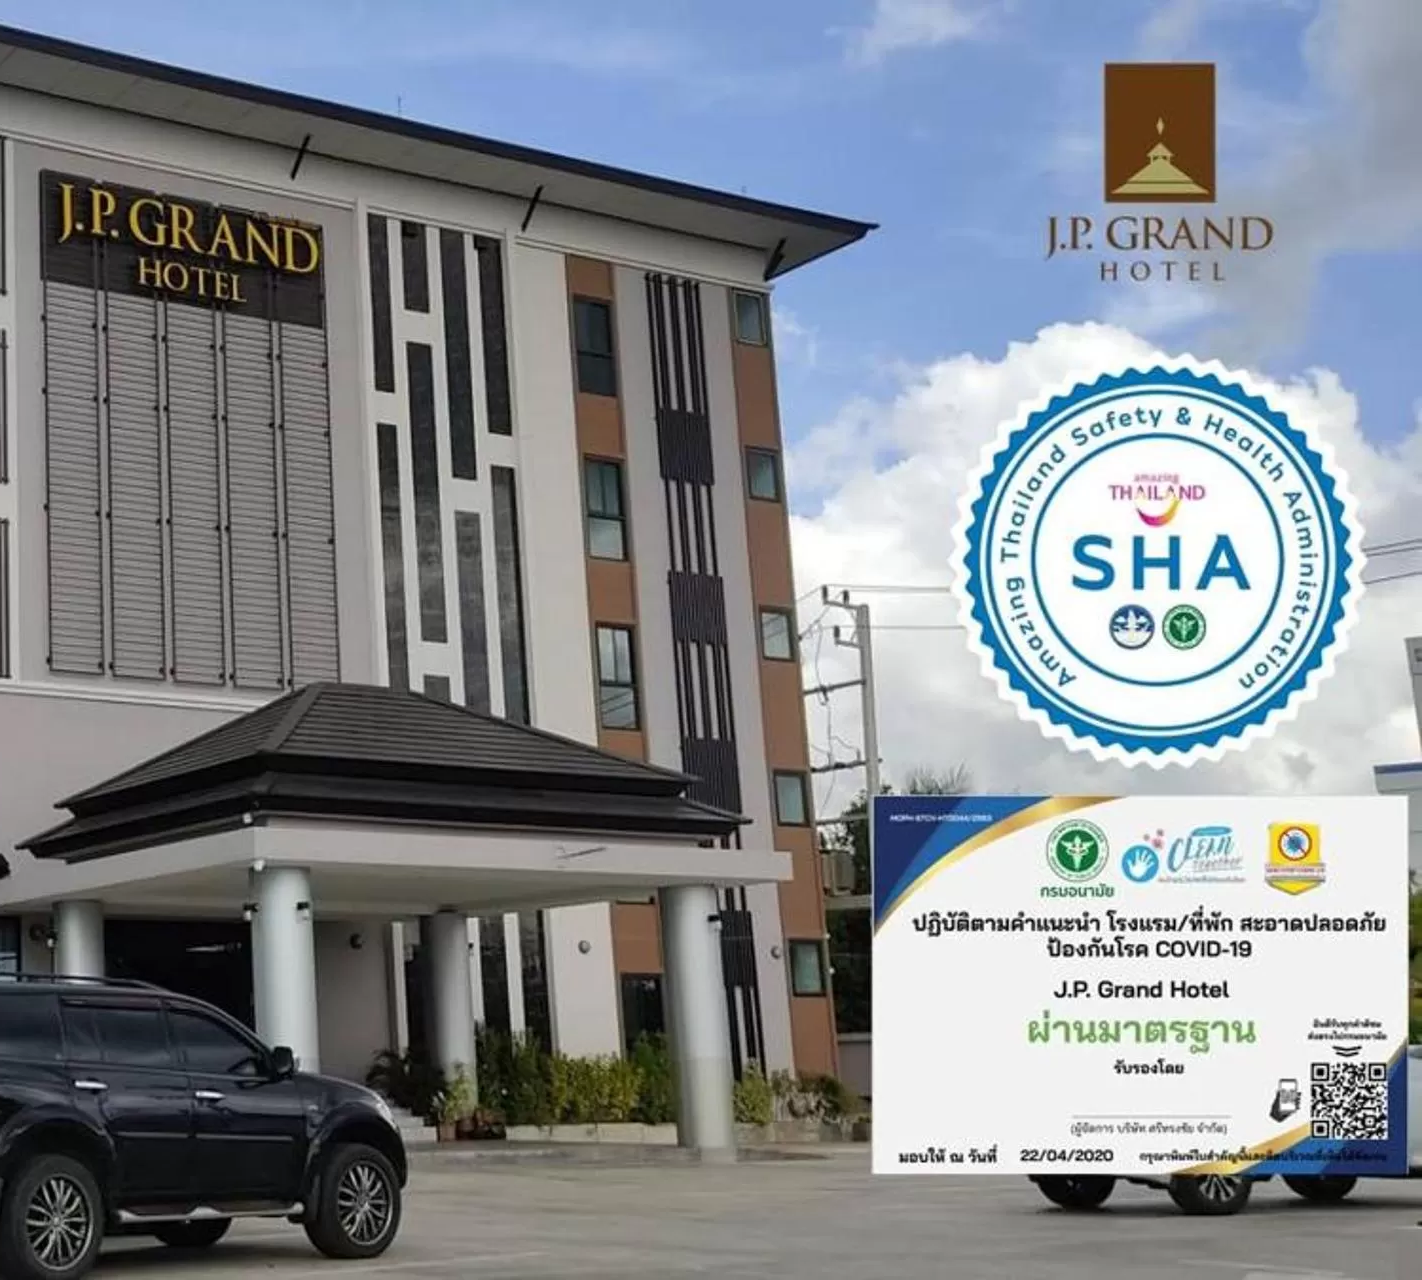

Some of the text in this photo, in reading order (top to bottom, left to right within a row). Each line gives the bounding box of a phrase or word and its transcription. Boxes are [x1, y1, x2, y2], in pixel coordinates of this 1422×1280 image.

[58, 181, 319, 273] J.P. GRAND
[139, 257, 247, 302] HOTEL
